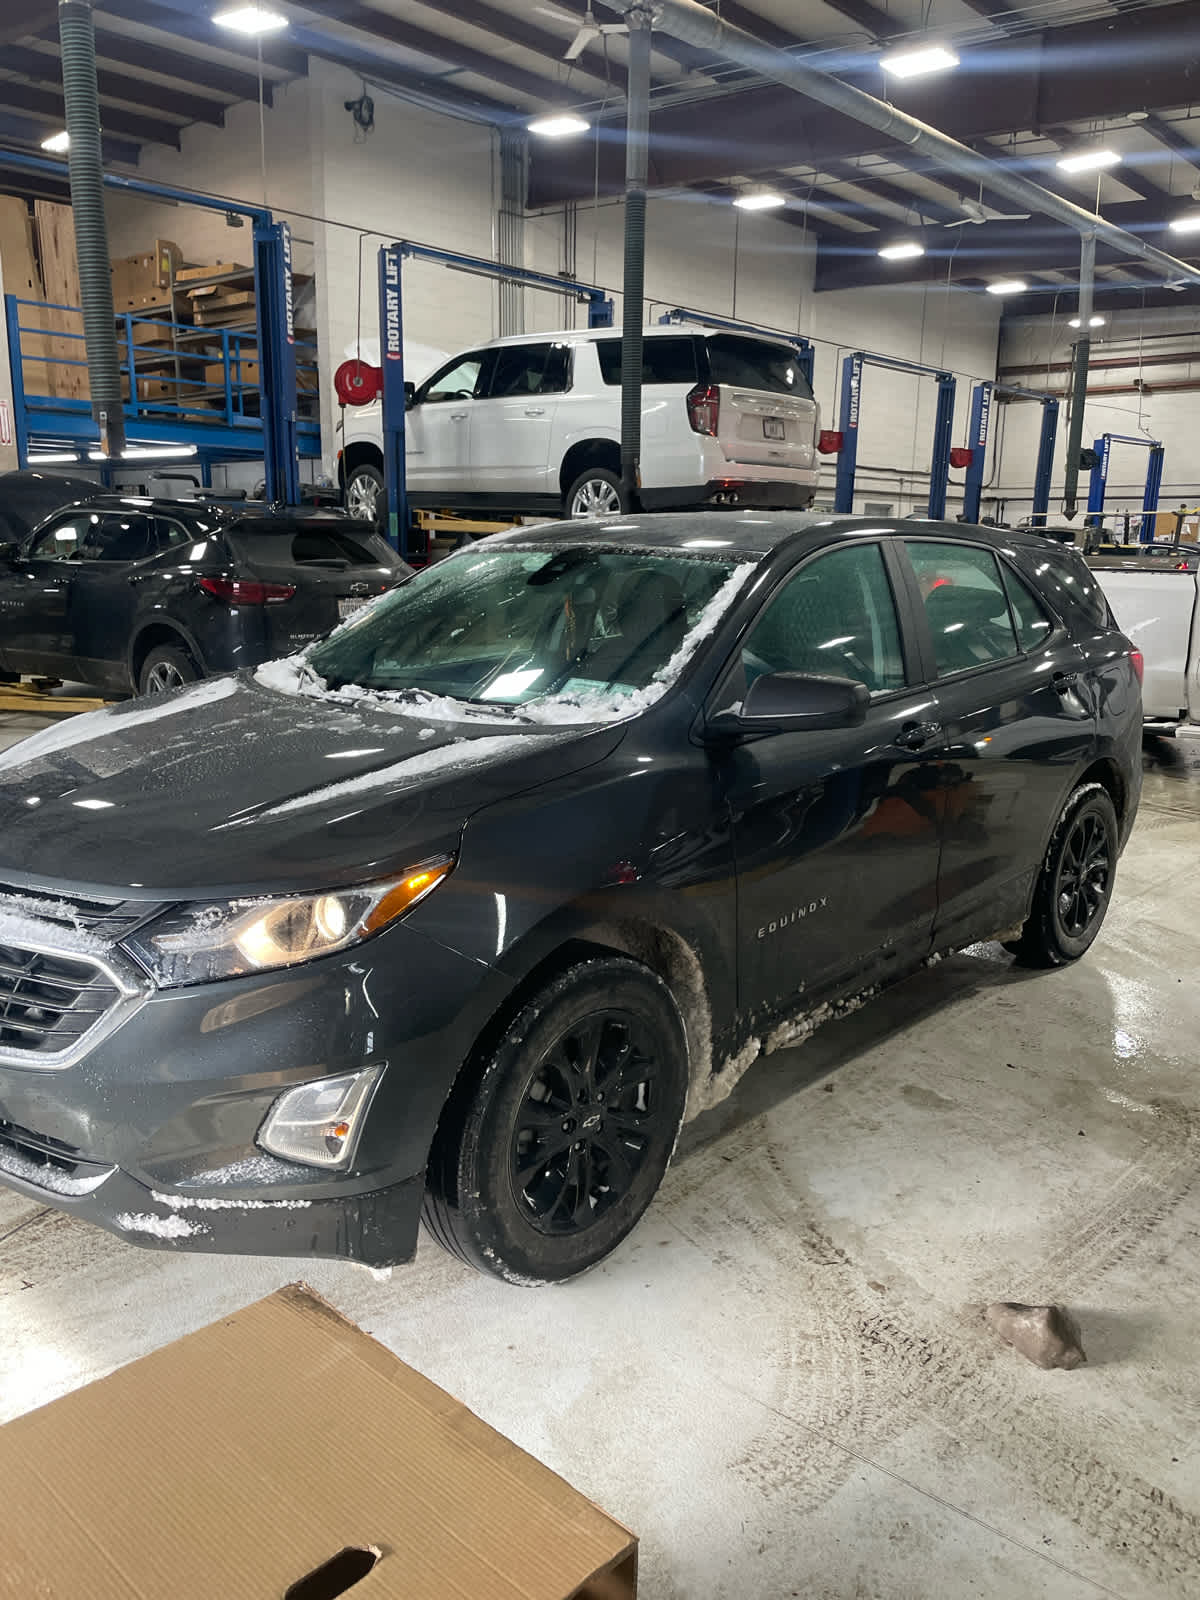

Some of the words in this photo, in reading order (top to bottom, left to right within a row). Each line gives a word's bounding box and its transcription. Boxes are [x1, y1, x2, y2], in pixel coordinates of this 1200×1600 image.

[283, 226, 291, 264] LIFT
[385, 251, 398, 285] LIFT
[285, 267, 294, 336] ROTARY
[386, 288, 400, 352] ROTARY
[852, 359, 861, 380] LIFT
[849, 383, 860, 422] ROTARY
[982, 387, 990, 405] LIFT
[979, 408, 988, 441] ROTARY
[757, 896, 827, 939] EQUINOX
